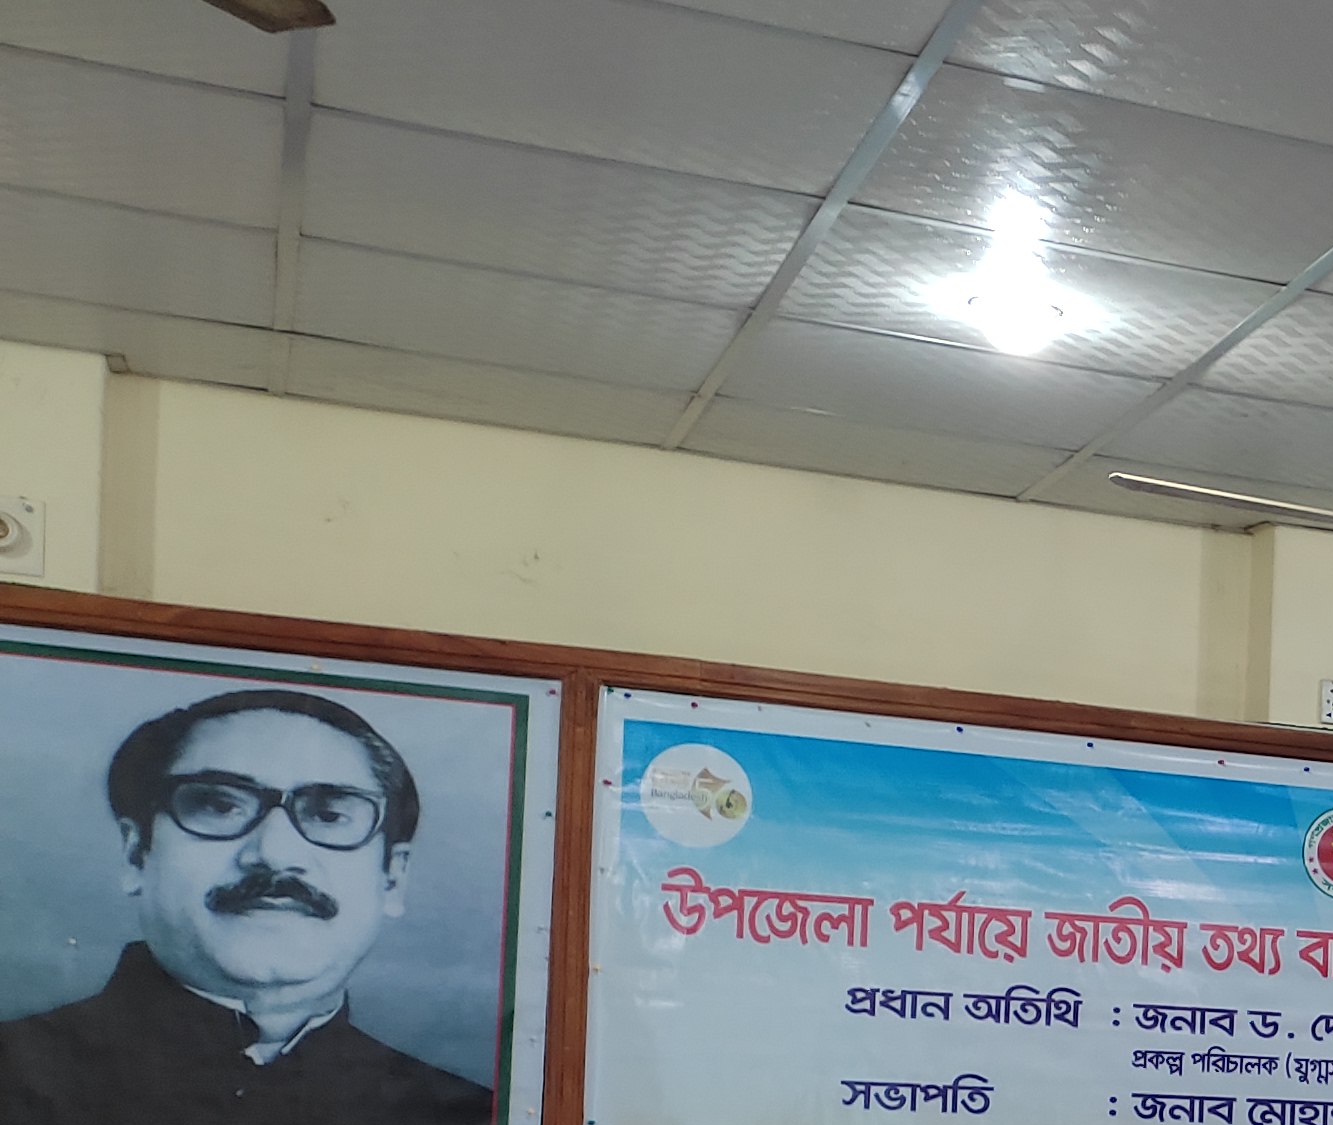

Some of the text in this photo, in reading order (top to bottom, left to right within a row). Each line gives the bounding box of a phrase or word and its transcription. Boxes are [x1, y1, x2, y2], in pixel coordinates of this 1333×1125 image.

[661, 866, 874, 948] উপজেলা
[889, 890, 1032, 963] পর্যায়ে
[1044, 896, 1188, 973] জাতীয়
[1200, 922, 1284, 975] তথ্য
[845, 987, 953, 1021] প্রধান
[963, 985, 1083, 1028] অতিথি
[1132, 1003, 1238, 1037] জনাব
[1131, 1049, 1185, 1076] প্রকল্প
[1191, 1046, 1280, 1075] পরিচালক
[841, 1073, 994, 1114] সভাপতি
[1131, 1092, 1237, 1124] জনাব
